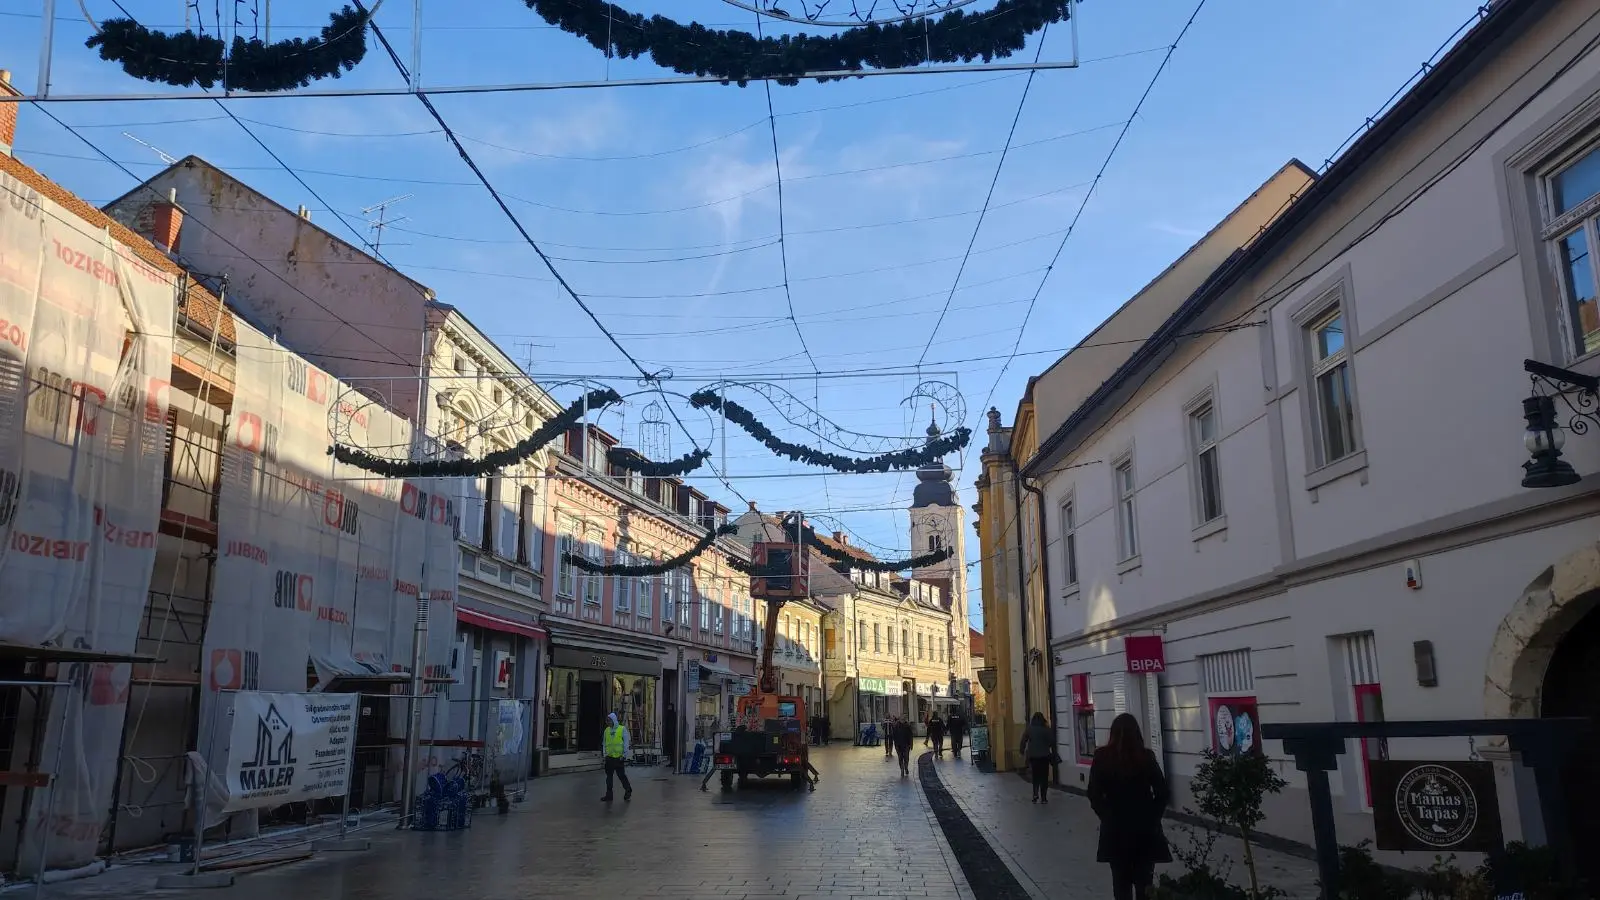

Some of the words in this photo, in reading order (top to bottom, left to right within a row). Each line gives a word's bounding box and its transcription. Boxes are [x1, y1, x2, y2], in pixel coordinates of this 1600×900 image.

[340, 498, 359, 535] JUB
[224, 540, 268, 566] JUBIZOL
[274, 569, 298, 609] JUB
[1130, 658, 1163, 671] BIPA
[240, 767, 295, 791] MALER
[1410, 792, 1461, 806] Mamas
[1416, 805, 1459, 822] Tapas
